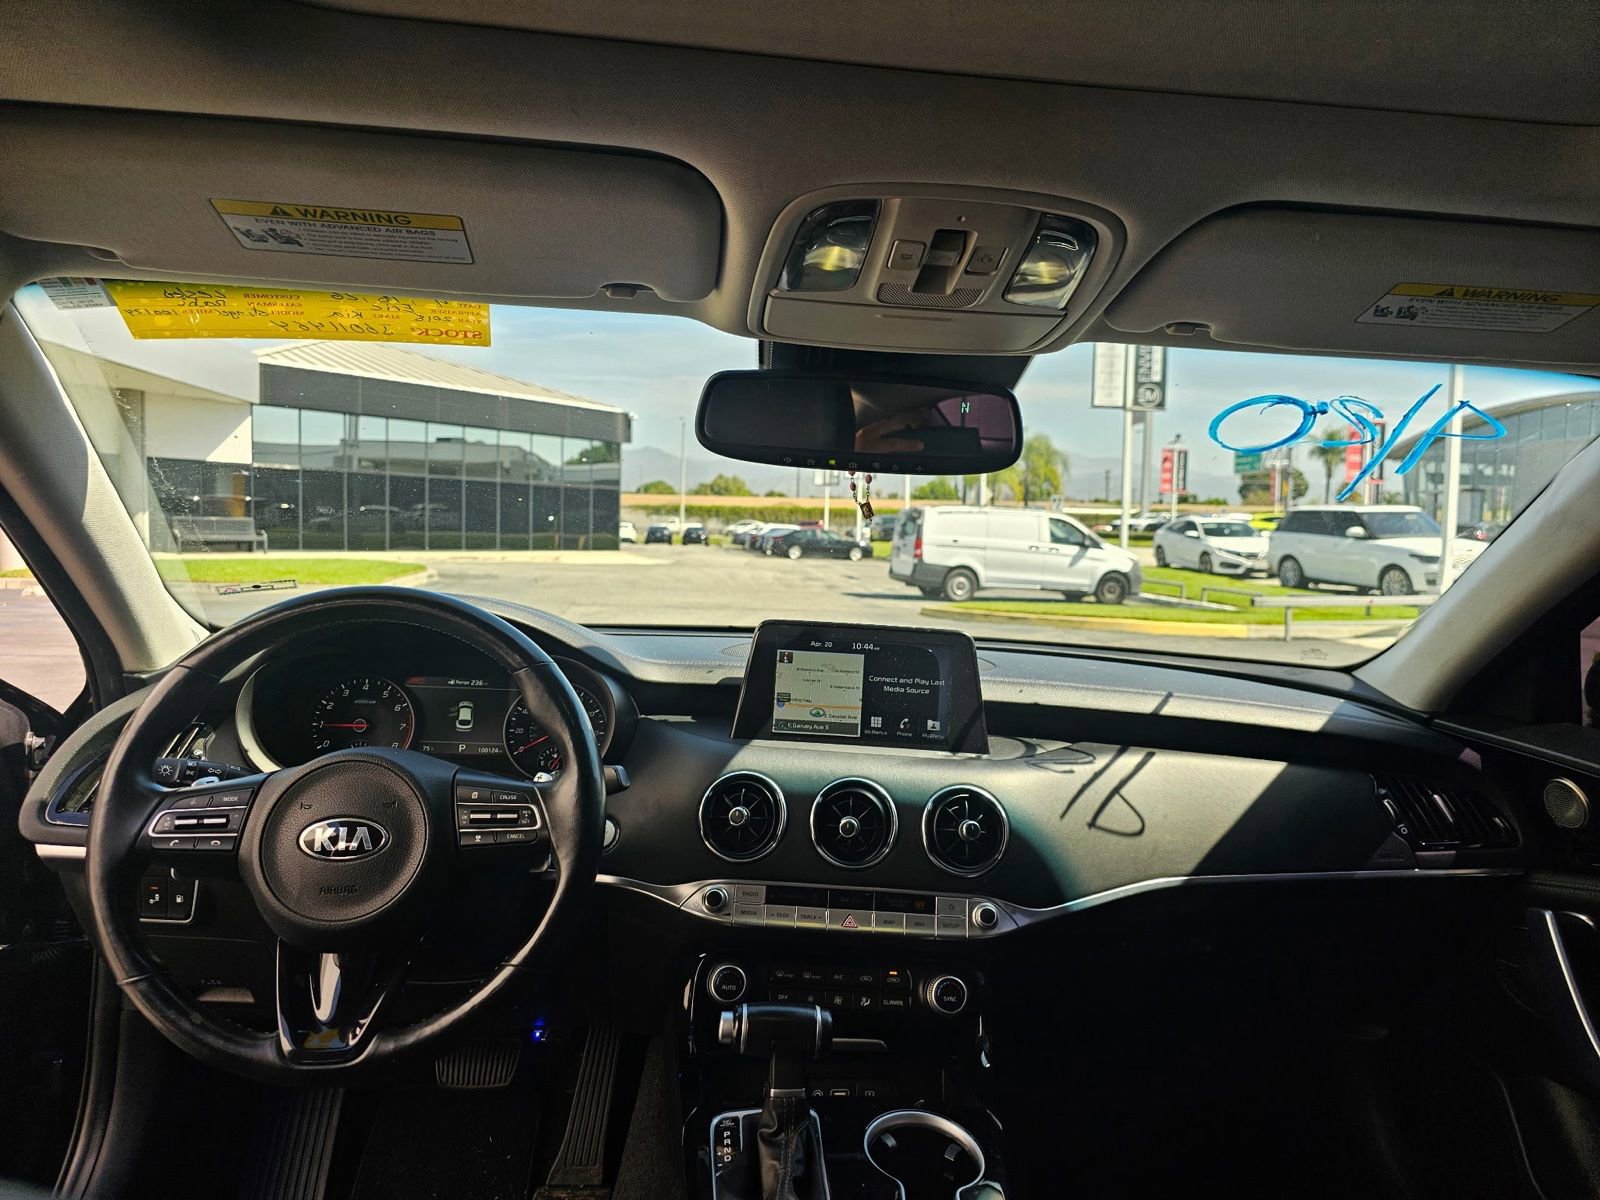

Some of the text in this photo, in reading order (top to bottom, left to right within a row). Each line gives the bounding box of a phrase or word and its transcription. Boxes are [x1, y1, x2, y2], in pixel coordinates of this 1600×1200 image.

[294, 206, 412, 226] WARNING
[254, 217, 285, 227] EVEN
[287, 219, 317, 229] WITH
[320, 221, 382, 234] ADVANCED
[385, 227, 403, 235] AIR
[404, 228, 435, 237] BAGS
[1461, 289, 1561, 302] WARNING
[961, 401, 970, 414] N
[852, 642, 873, 650] 10:44
[869, 675, 898, 683] Connect
[914, 678, 930, 686] Play
[342, 689, 350, 697] 3
[382, 690, 389, 698] 5
[883, 685, 930, 694] Media Source
[326, 701, 334, 710] 2
[394, 704, 401, 712] 6
[322, 739, 330, 748] 0
[458, 743, 466, 752] P
[313, 826, 373, 852] KIA
[320, 885, 358, 895] AIRBAG
[721, 983, 738, 991] AUTO
[723, 1138, 731, 1146] R
[723, 1154, 732, 1162] D
